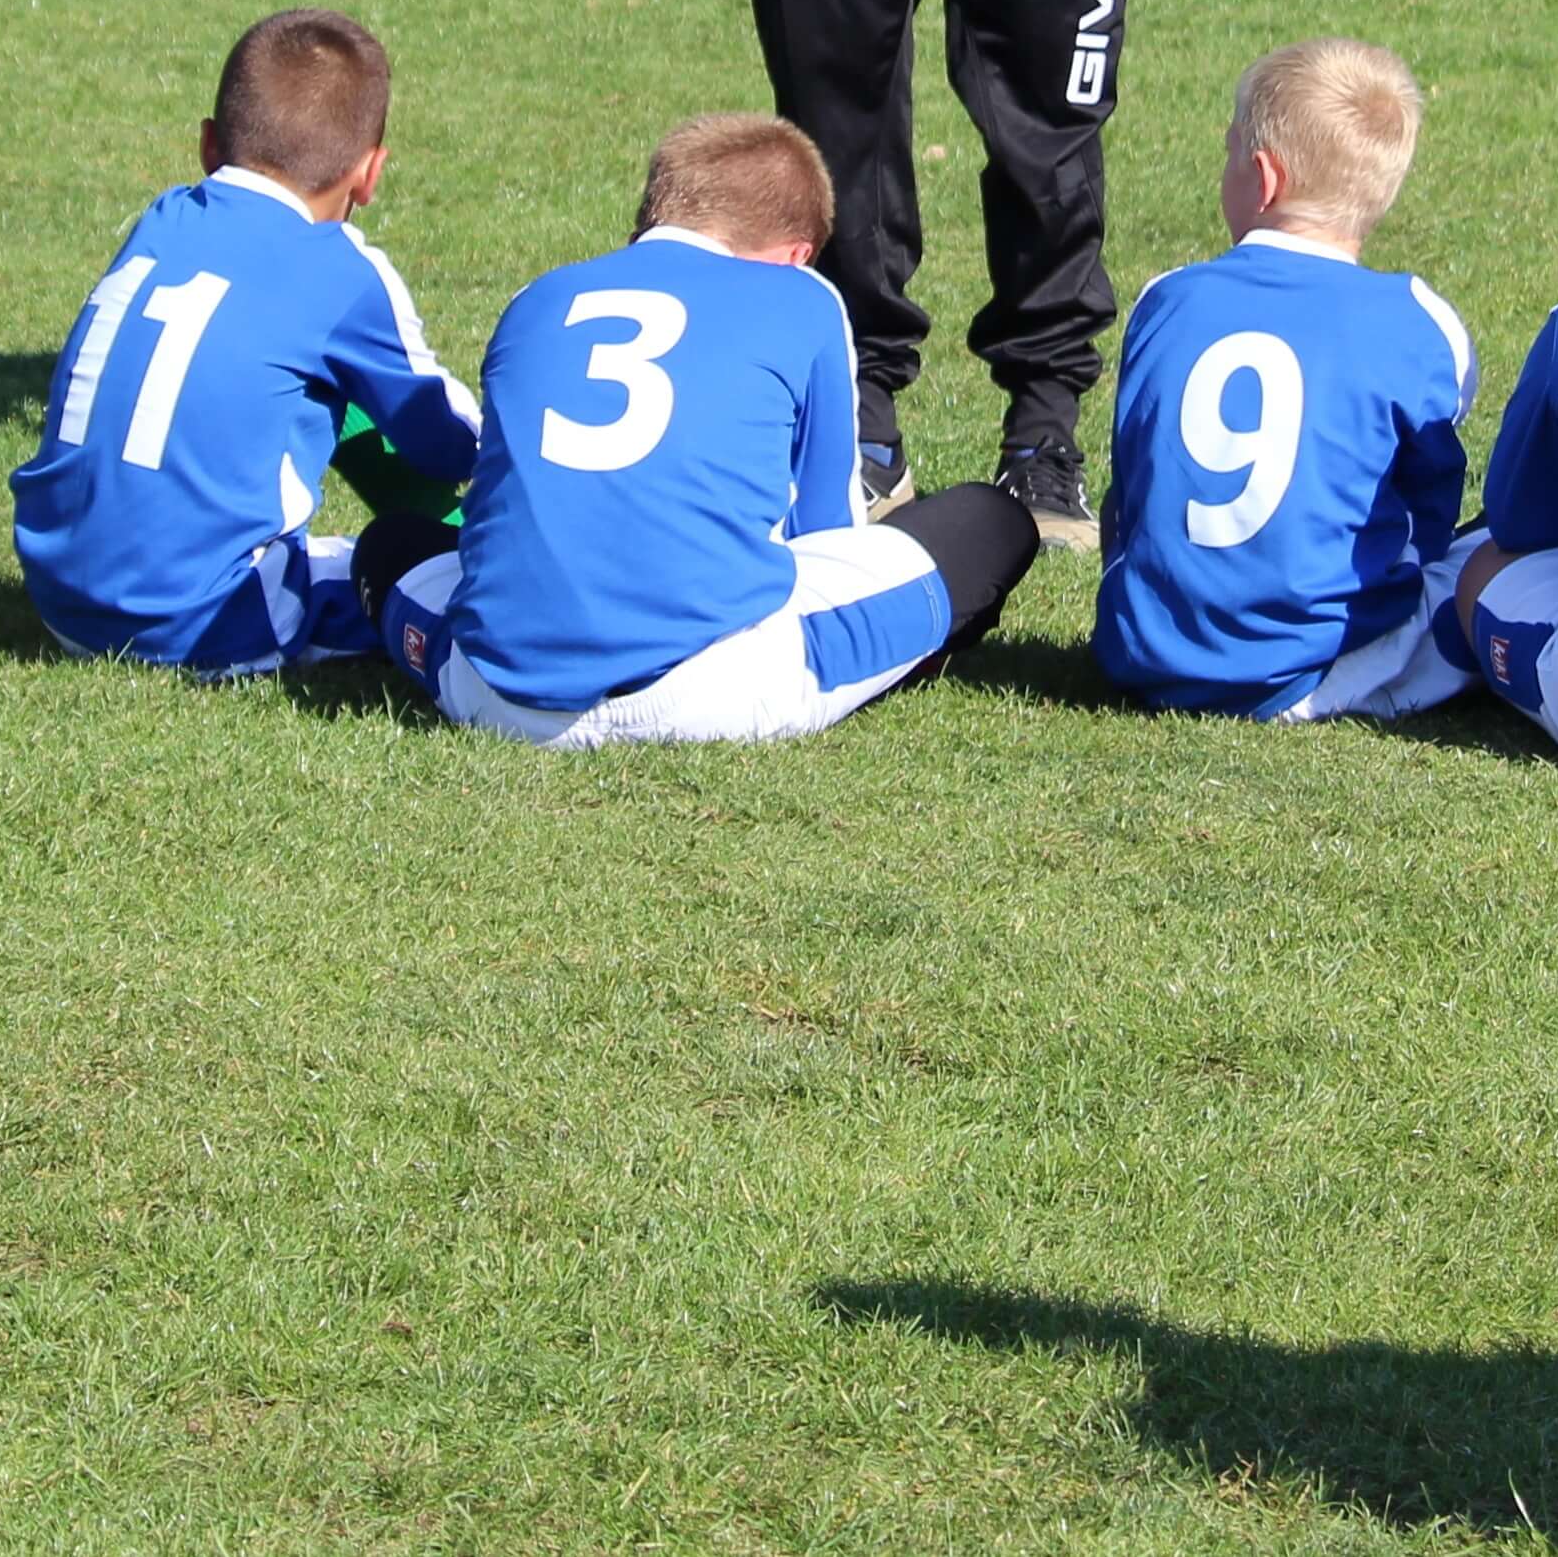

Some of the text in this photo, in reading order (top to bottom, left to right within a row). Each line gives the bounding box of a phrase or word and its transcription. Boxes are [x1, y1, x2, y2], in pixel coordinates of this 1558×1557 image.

[60, 256, 230, 469] 11
[541, 290, 687, 470] 3
[1180, 331, 1304, 547] 9
